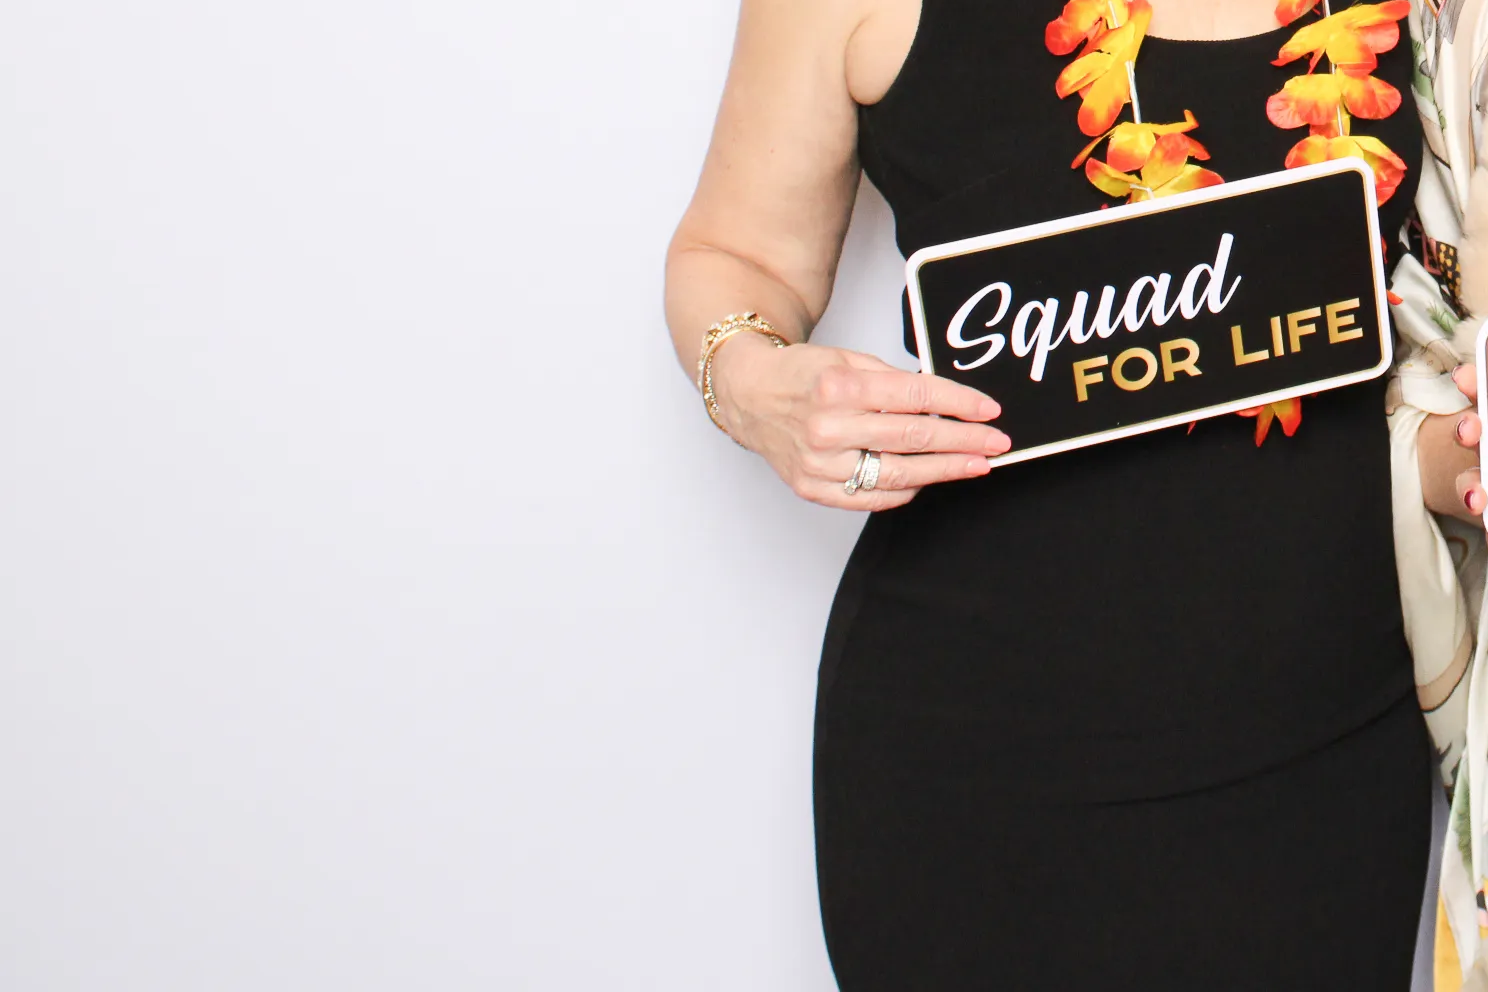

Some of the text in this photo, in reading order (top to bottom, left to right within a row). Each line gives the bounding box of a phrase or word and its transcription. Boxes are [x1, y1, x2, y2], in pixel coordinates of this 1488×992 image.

[946, 233, 1242, 382] Squad
[1072, 298, 1363, 402] FOR LIFE
